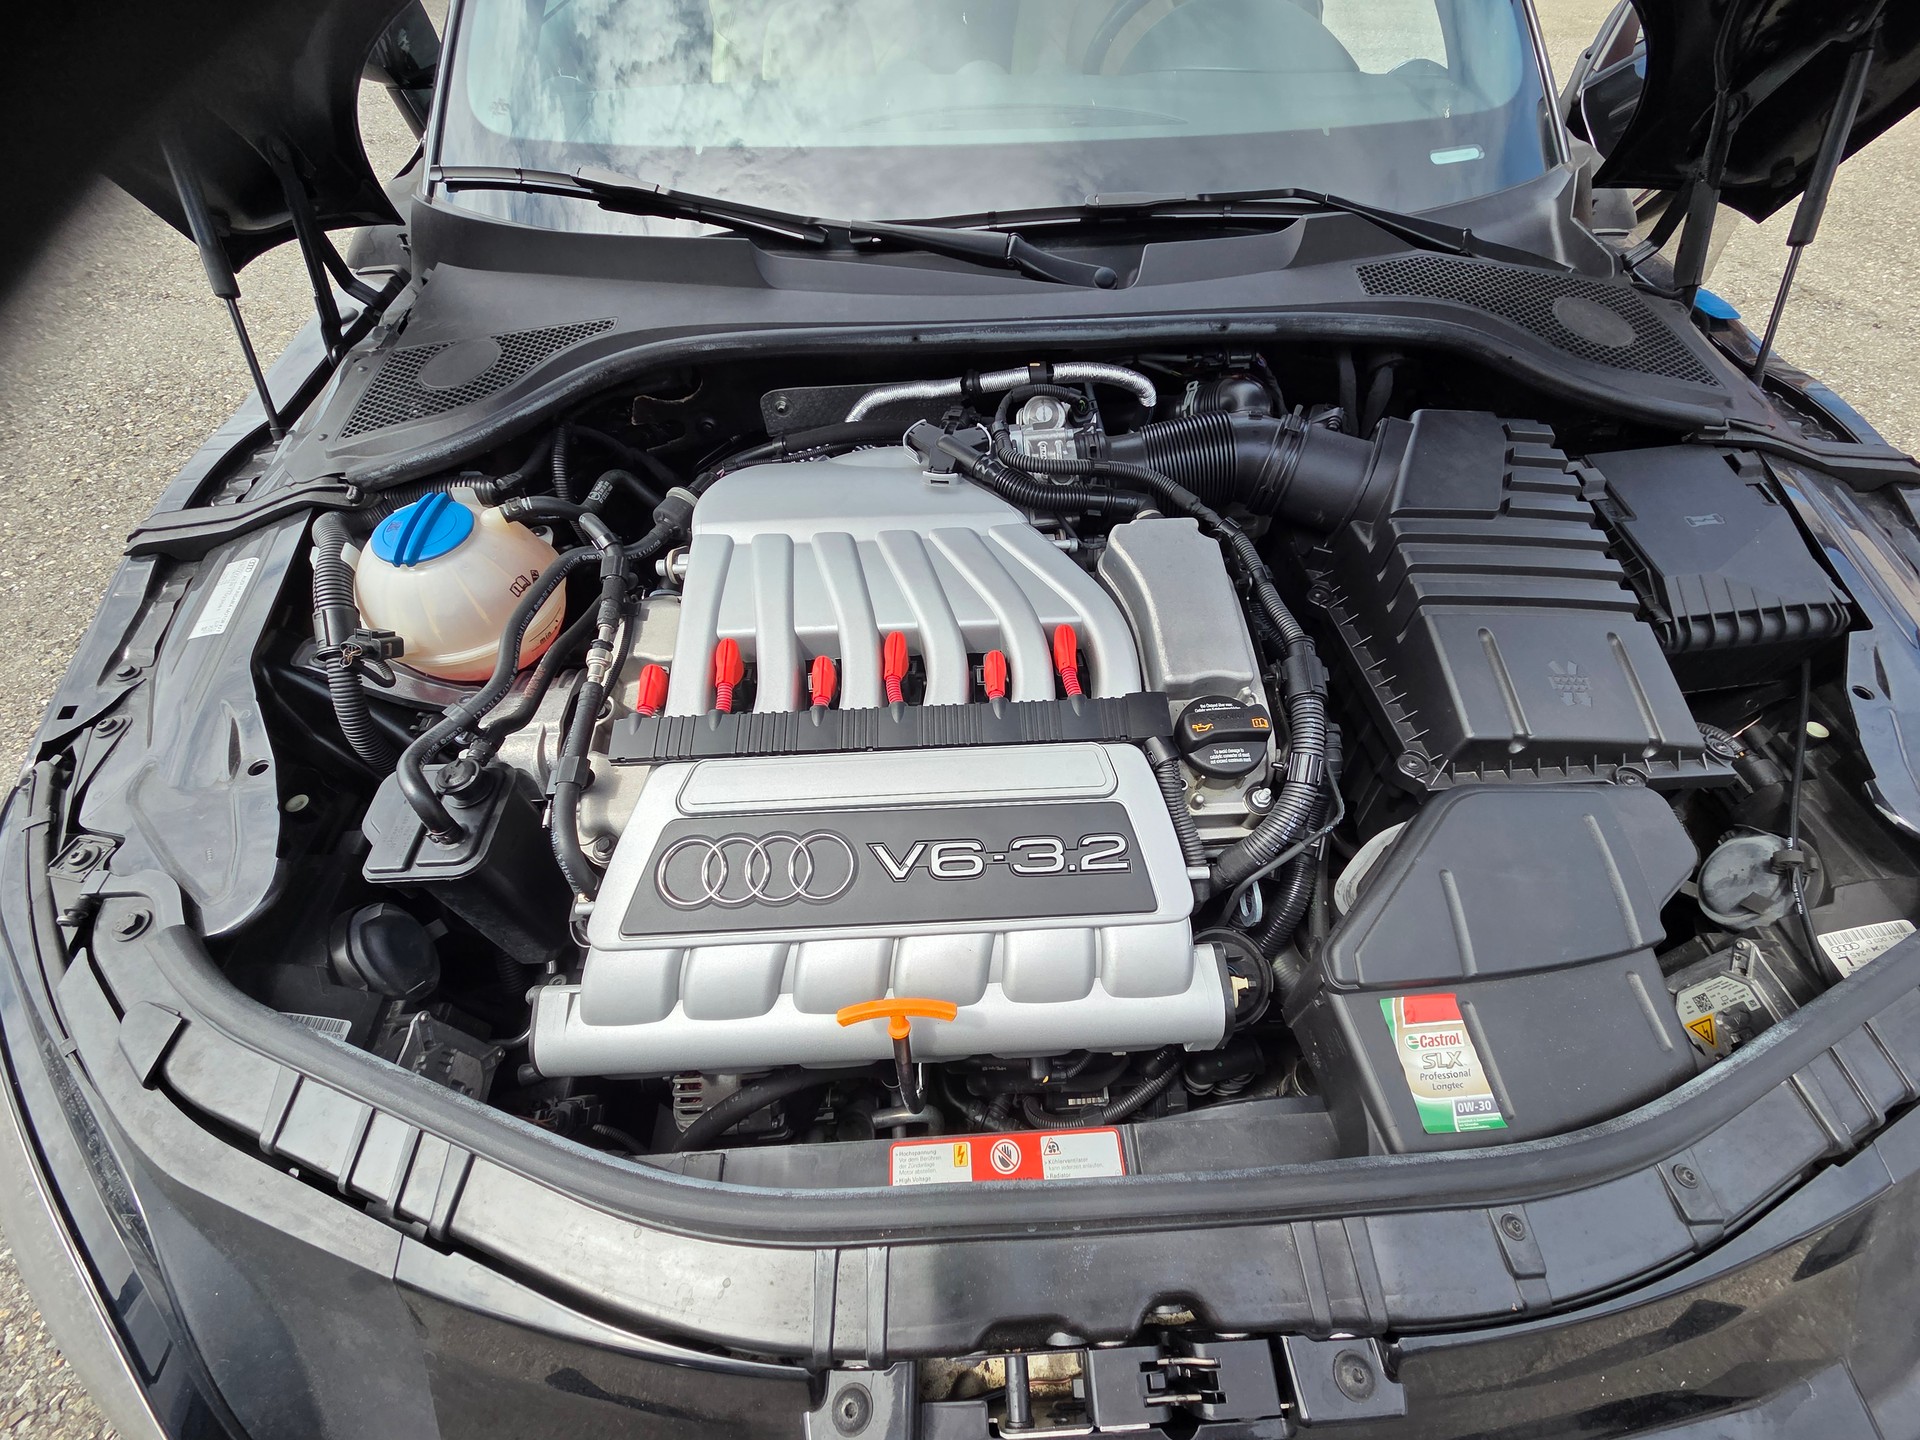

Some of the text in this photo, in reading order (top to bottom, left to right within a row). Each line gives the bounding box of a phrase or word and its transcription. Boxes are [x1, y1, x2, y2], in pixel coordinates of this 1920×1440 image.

[869, 834, 1131, 882] V6-3.2
[1420, 1033, 1461, 1048] Castrol
[1421, 1050, 1463, 1070] SLX
[1419, 1069, 1471, 1081] Professional
[1432, 1082, 1464, 1092] Longtec
[1457, 1100, 1492, 1113] 0W-30
